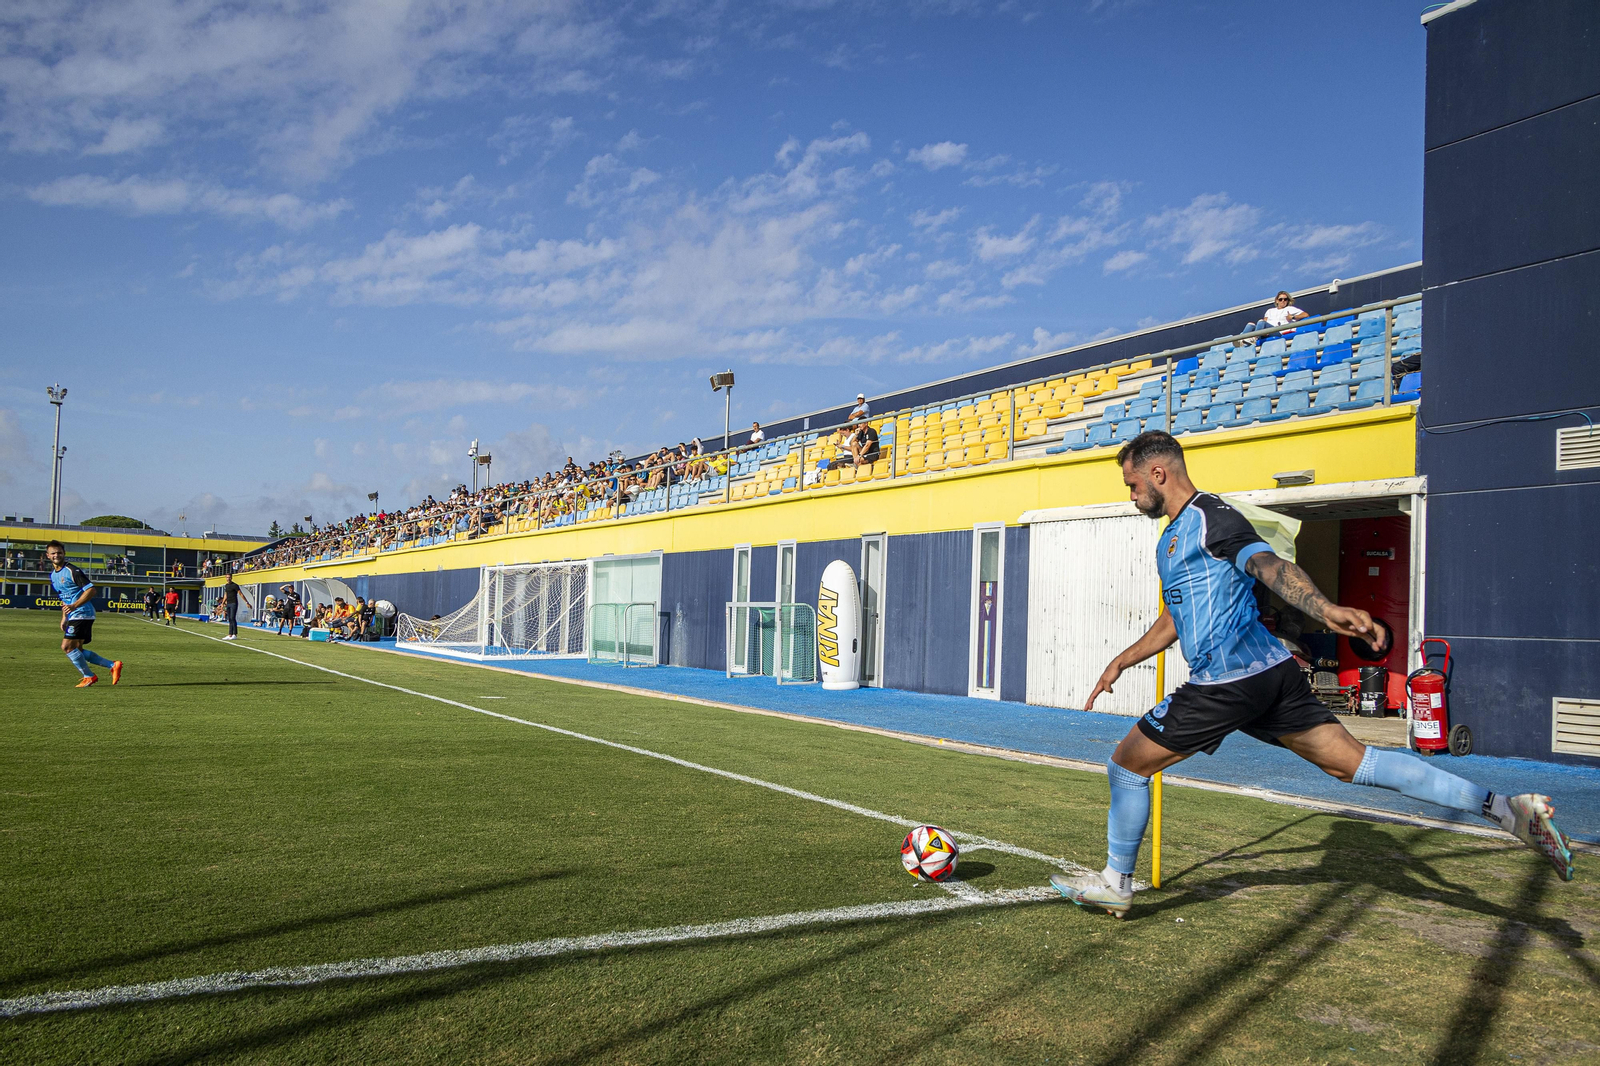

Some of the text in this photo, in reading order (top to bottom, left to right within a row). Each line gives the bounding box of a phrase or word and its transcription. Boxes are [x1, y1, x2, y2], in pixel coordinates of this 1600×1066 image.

[35, 597, 64, 607] Cruzca
[107, 600, 146, 611] Cruzcamp
[817, 580, 840, 668] RINAT
[1144, 713, 1165, 732] EGEA
